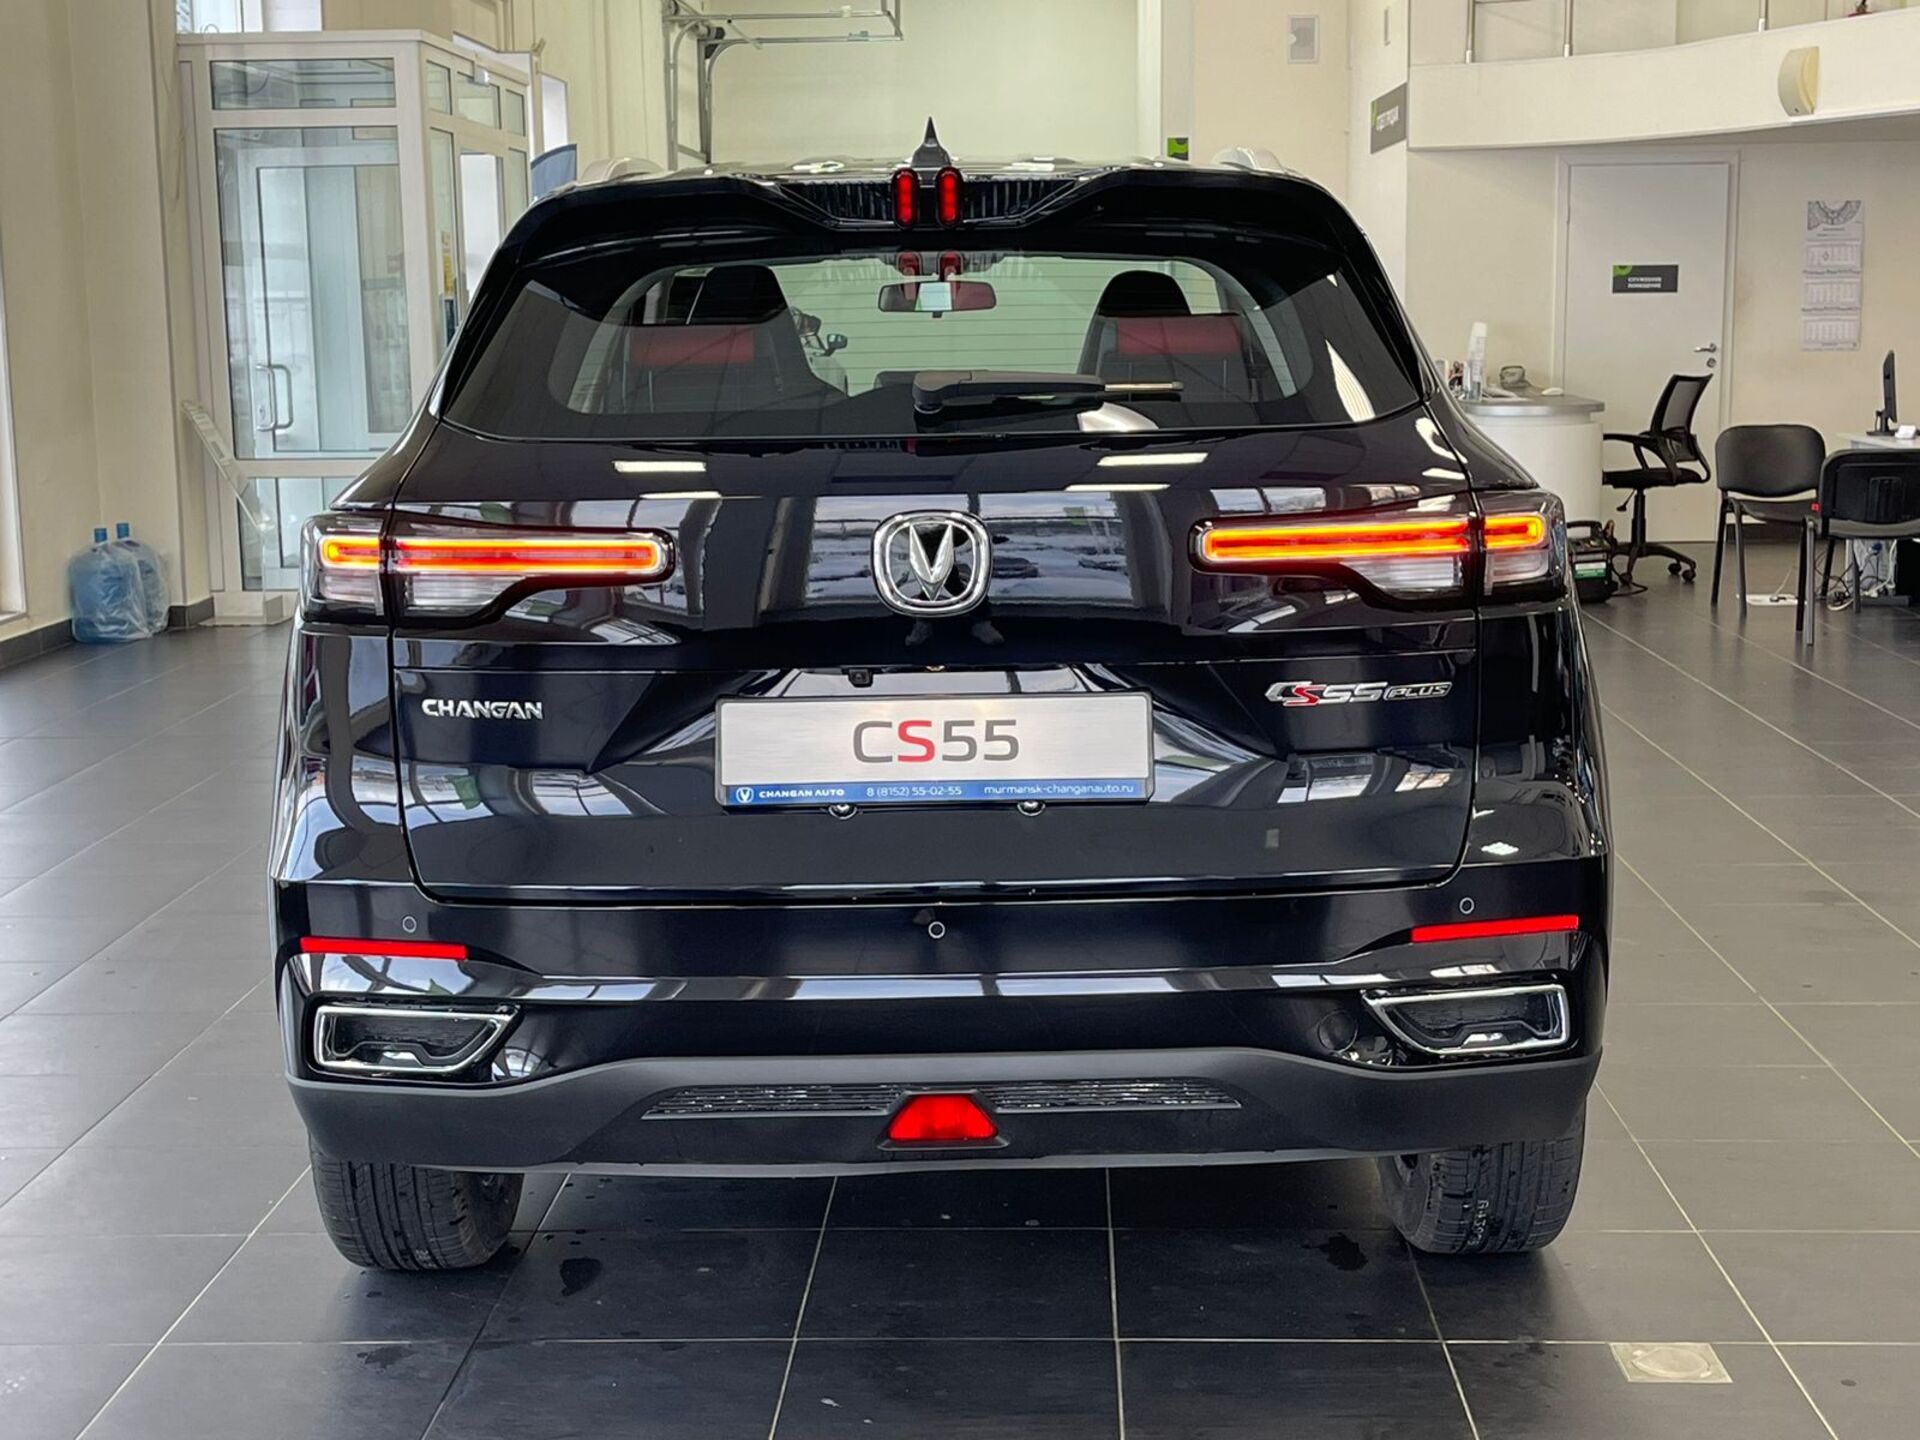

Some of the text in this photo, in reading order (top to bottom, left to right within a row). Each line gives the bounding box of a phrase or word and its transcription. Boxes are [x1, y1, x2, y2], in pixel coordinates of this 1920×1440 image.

[1386, 683, 1451, 700] PLUS
[421, 698, 543, 719] CHANGAN
[853, 719, 1020, 763] CS55
[758, 788, 846, 799] CHANGAN AUTO
[866, 786, 962, 798] 8 (8152) 55-02-55
[983, 783, 1135, 796] murmansk-changanauto.ru
